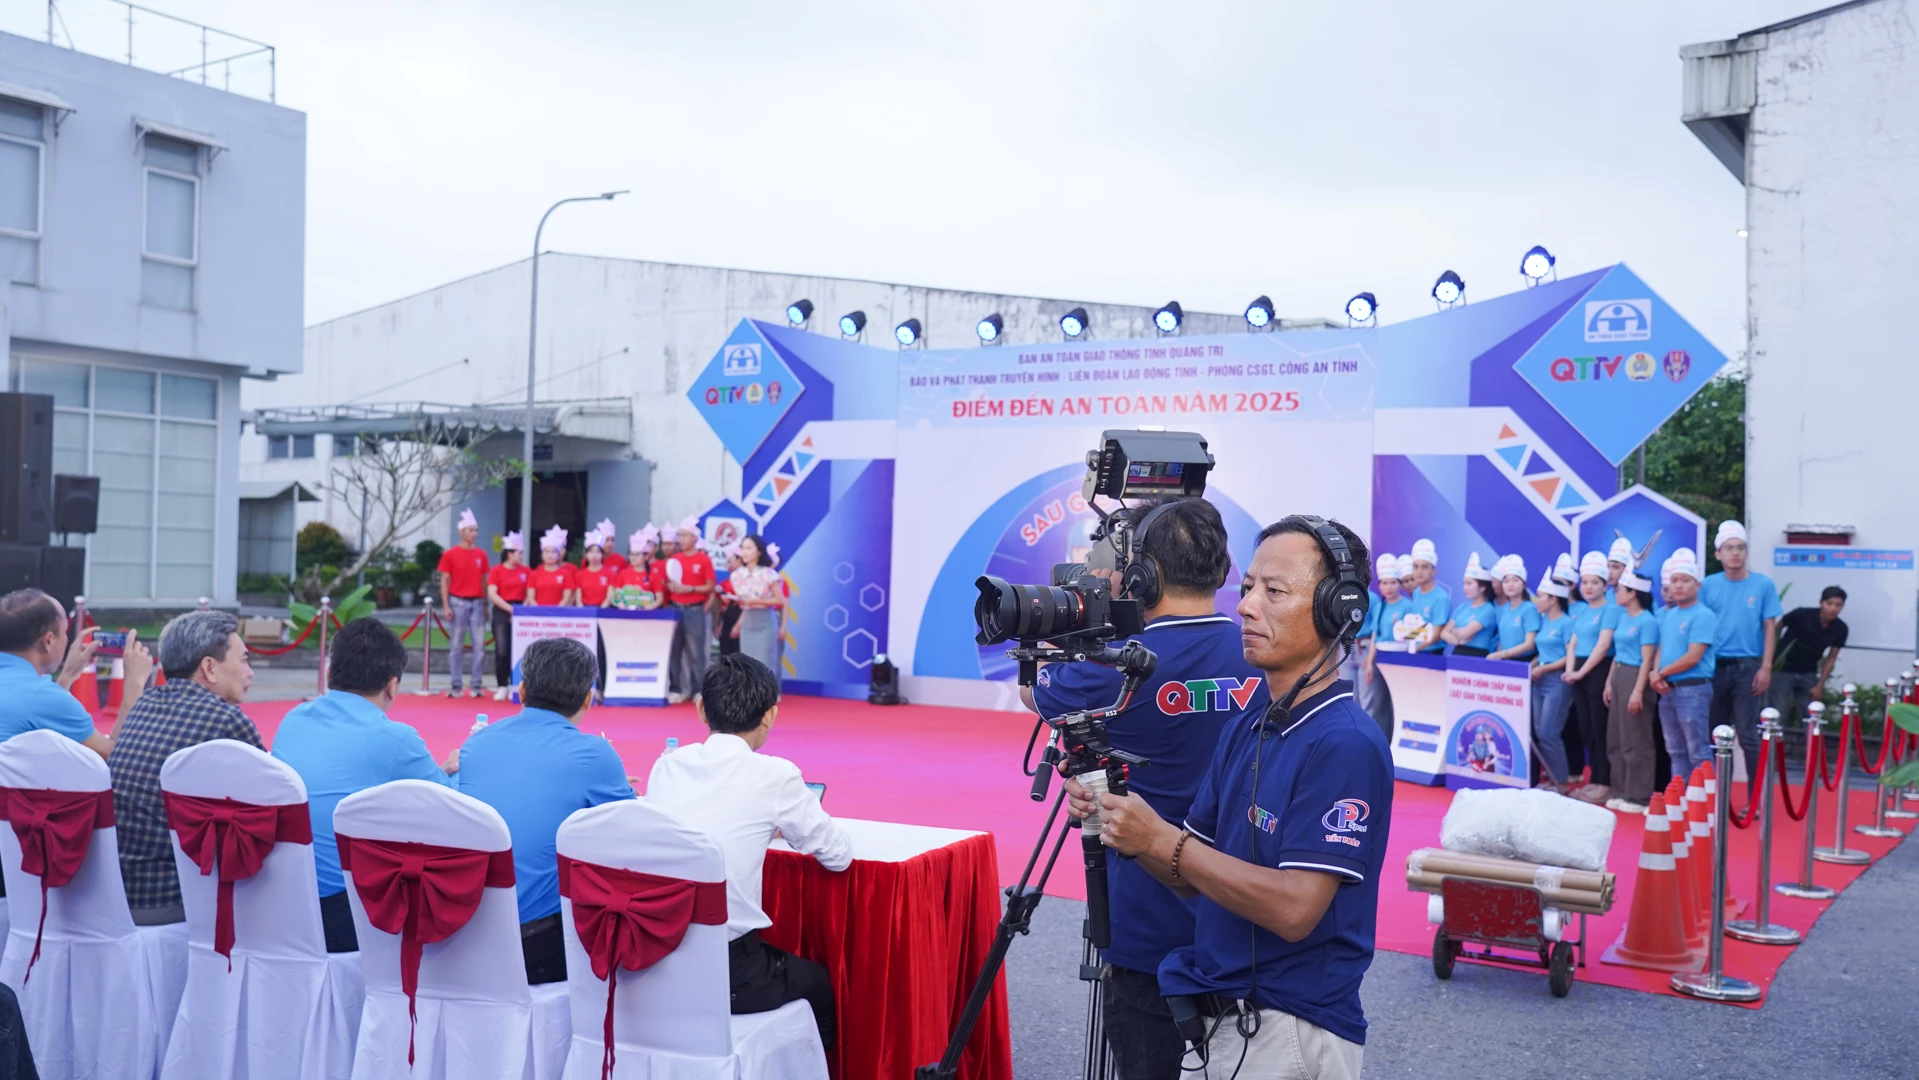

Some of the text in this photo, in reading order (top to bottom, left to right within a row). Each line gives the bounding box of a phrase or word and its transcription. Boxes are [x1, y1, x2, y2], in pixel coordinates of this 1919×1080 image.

[1018, 353, 1037, 364] BAN
[1040, 353, 1053, 364] AN
[1083, 350, 1105, 362] GIAO
[1109, 347, 1141, 361] THÔNG
[968, 374, 997, 385] THANH
[1123, 369, 1140, 380] LAO
[1279, 361, 1309, 375] CÔNG
[1313, 361, 1328, 374] AN
[1010, 390, 1054, 417] ĐẾN
[1059, 397, 1092, 416] AN
[1097, 388, 1167, 415] TOÀN
[1173, 390, 1228, 413] NĂM
[1234, 391, 1300, 413] 2025
[1021, 500, 1064, 546] SAU
[1156, 677, 1262, 715] QTTV
